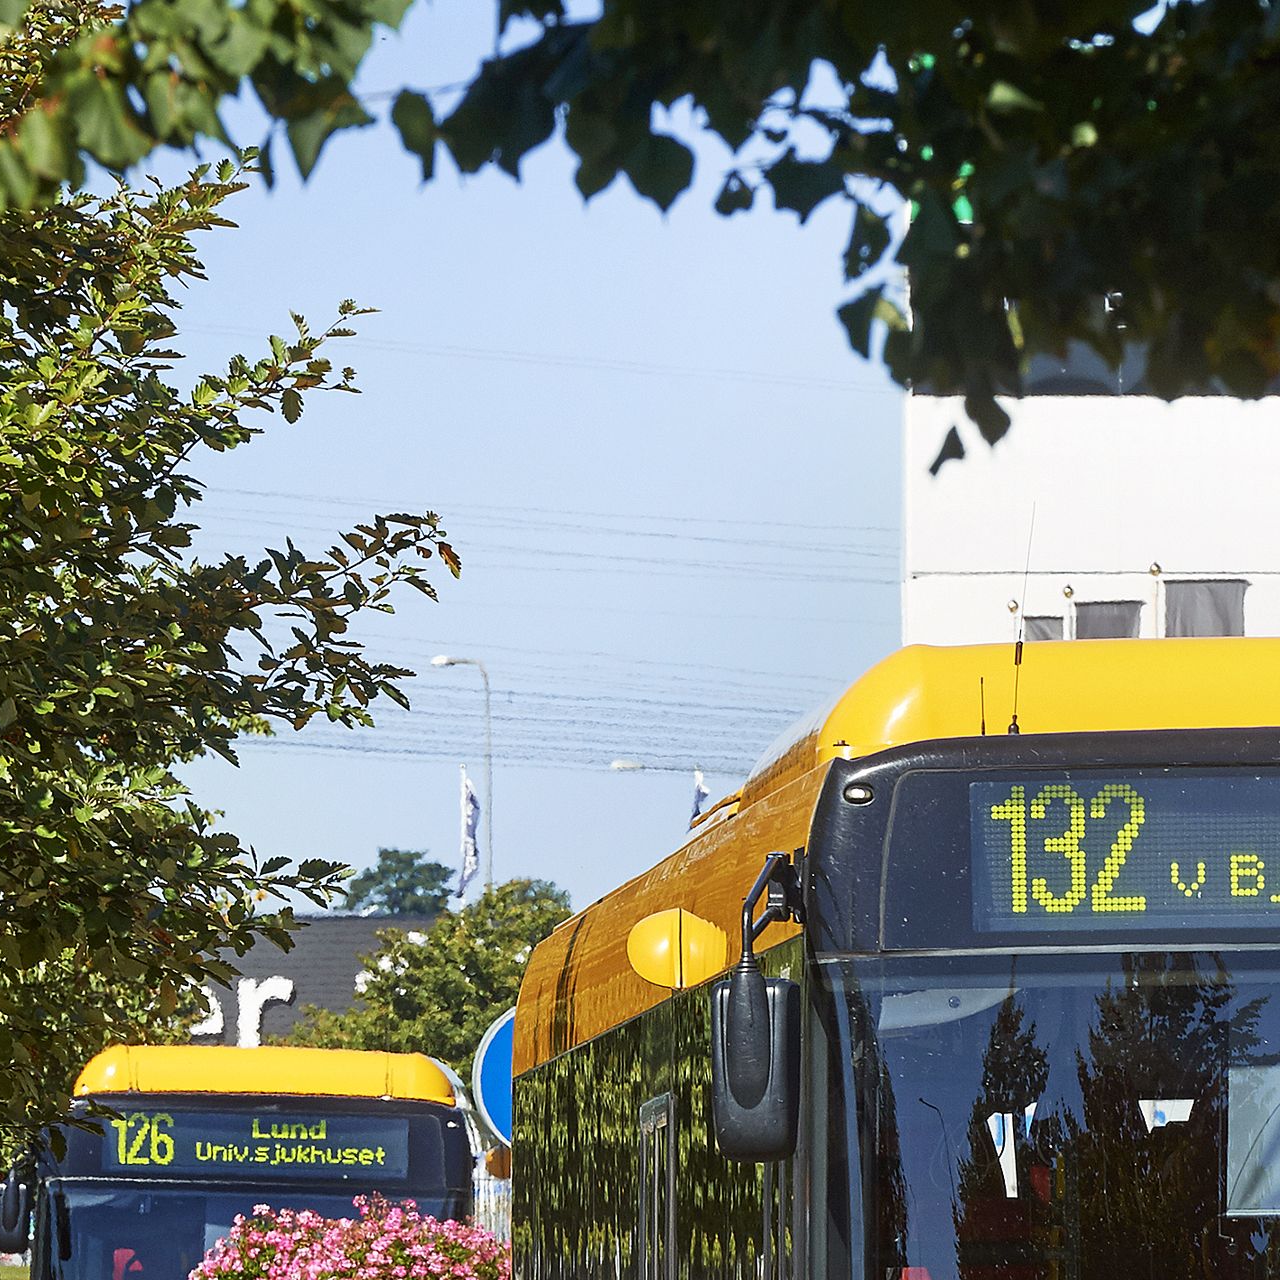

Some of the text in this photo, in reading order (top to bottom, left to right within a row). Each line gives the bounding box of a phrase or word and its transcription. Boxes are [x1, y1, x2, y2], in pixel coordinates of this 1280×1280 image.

[990, 784, 1147, 913] 132
[1171, 861, 1206, 897] v
[111, 1111, 175, 1165] 126
[251, 1117, 328, 1140] Lund
[195, 1141, 387, 1166] Univ.sjukhuset
